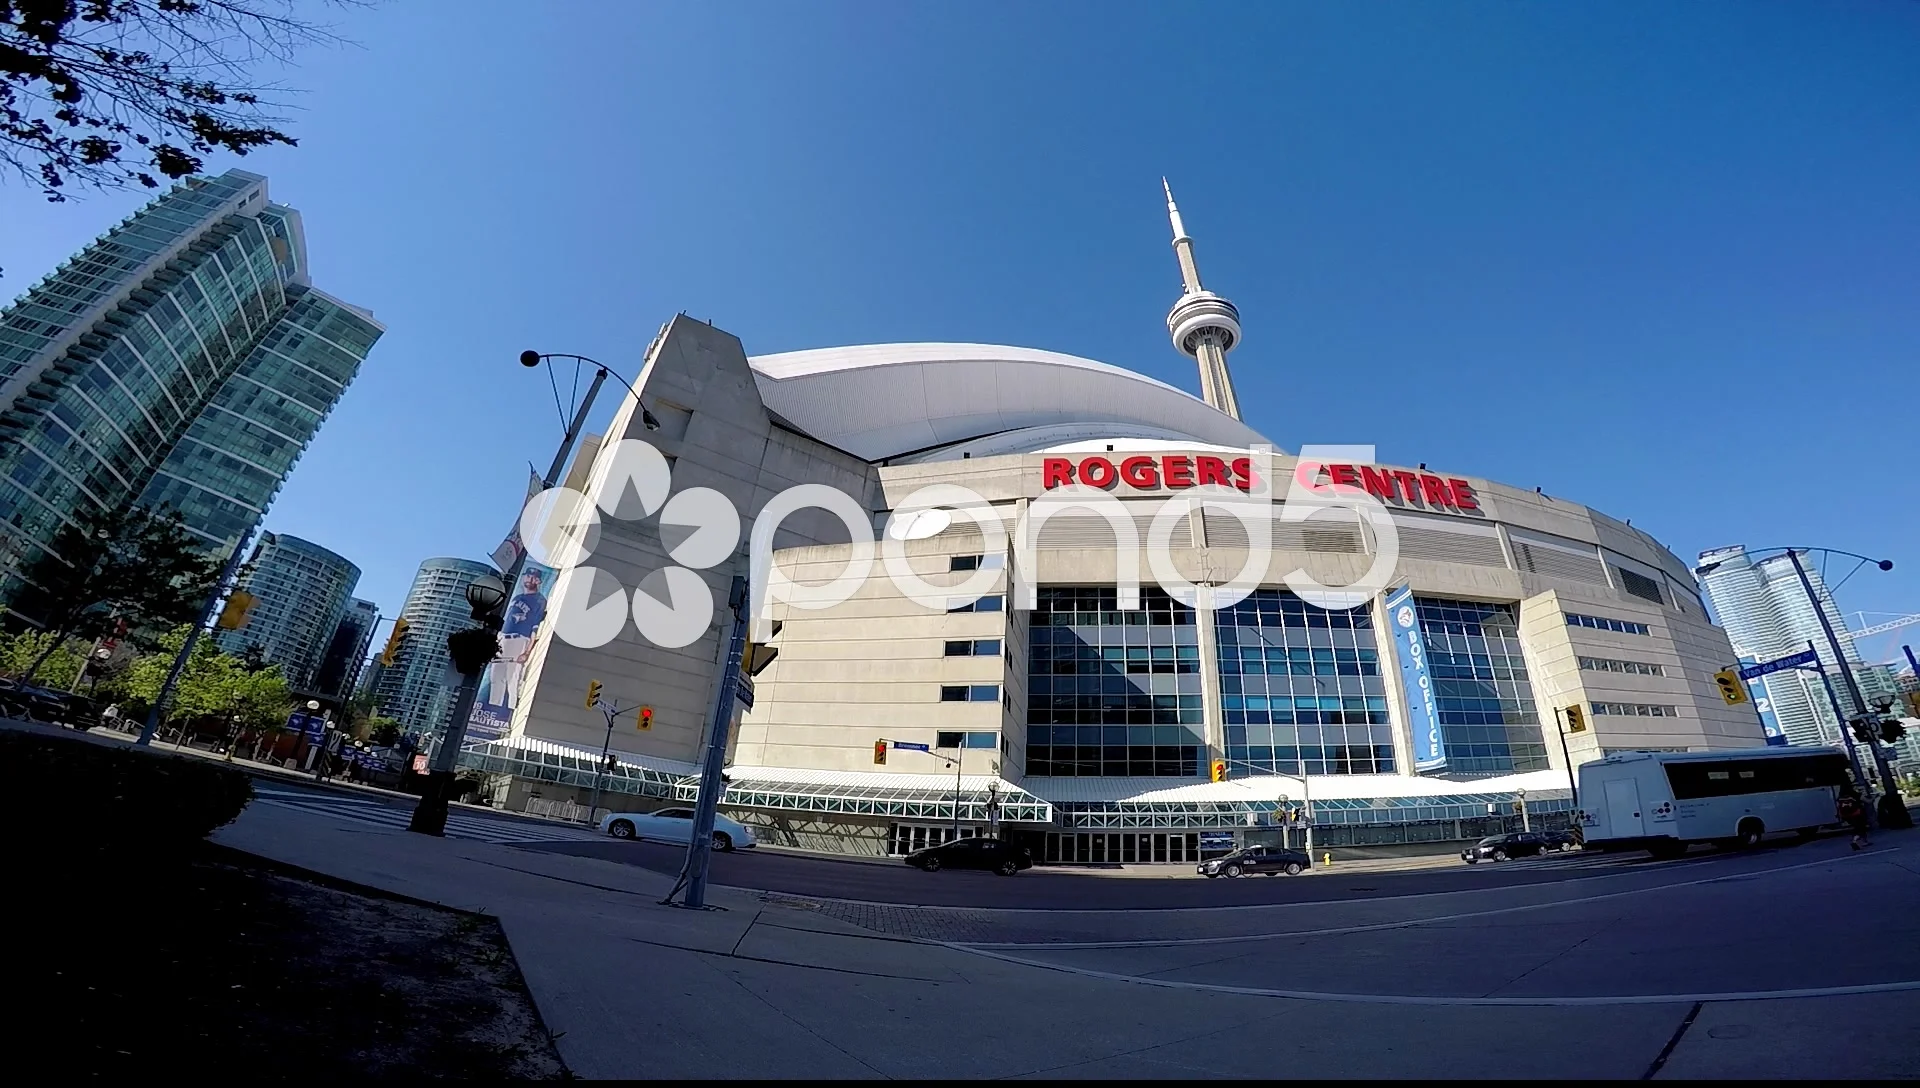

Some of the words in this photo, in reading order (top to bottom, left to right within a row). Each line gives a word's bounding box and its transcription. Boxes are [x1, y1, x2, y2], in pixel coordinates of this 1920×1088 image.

[1043, 456, 1259, 491] ROGERS
[1296, 461, 1477, 510] CENTRE
[1743, 669, 1761, 678] Van
[1762, 664, 1774, 673] de
[1776, 655, 1802, 668] Water
[1407, 630, 1424, 670] BOX
[1418, 674, 1439, 757] OFFICE
[471, 708, 498, 720] JOSE
